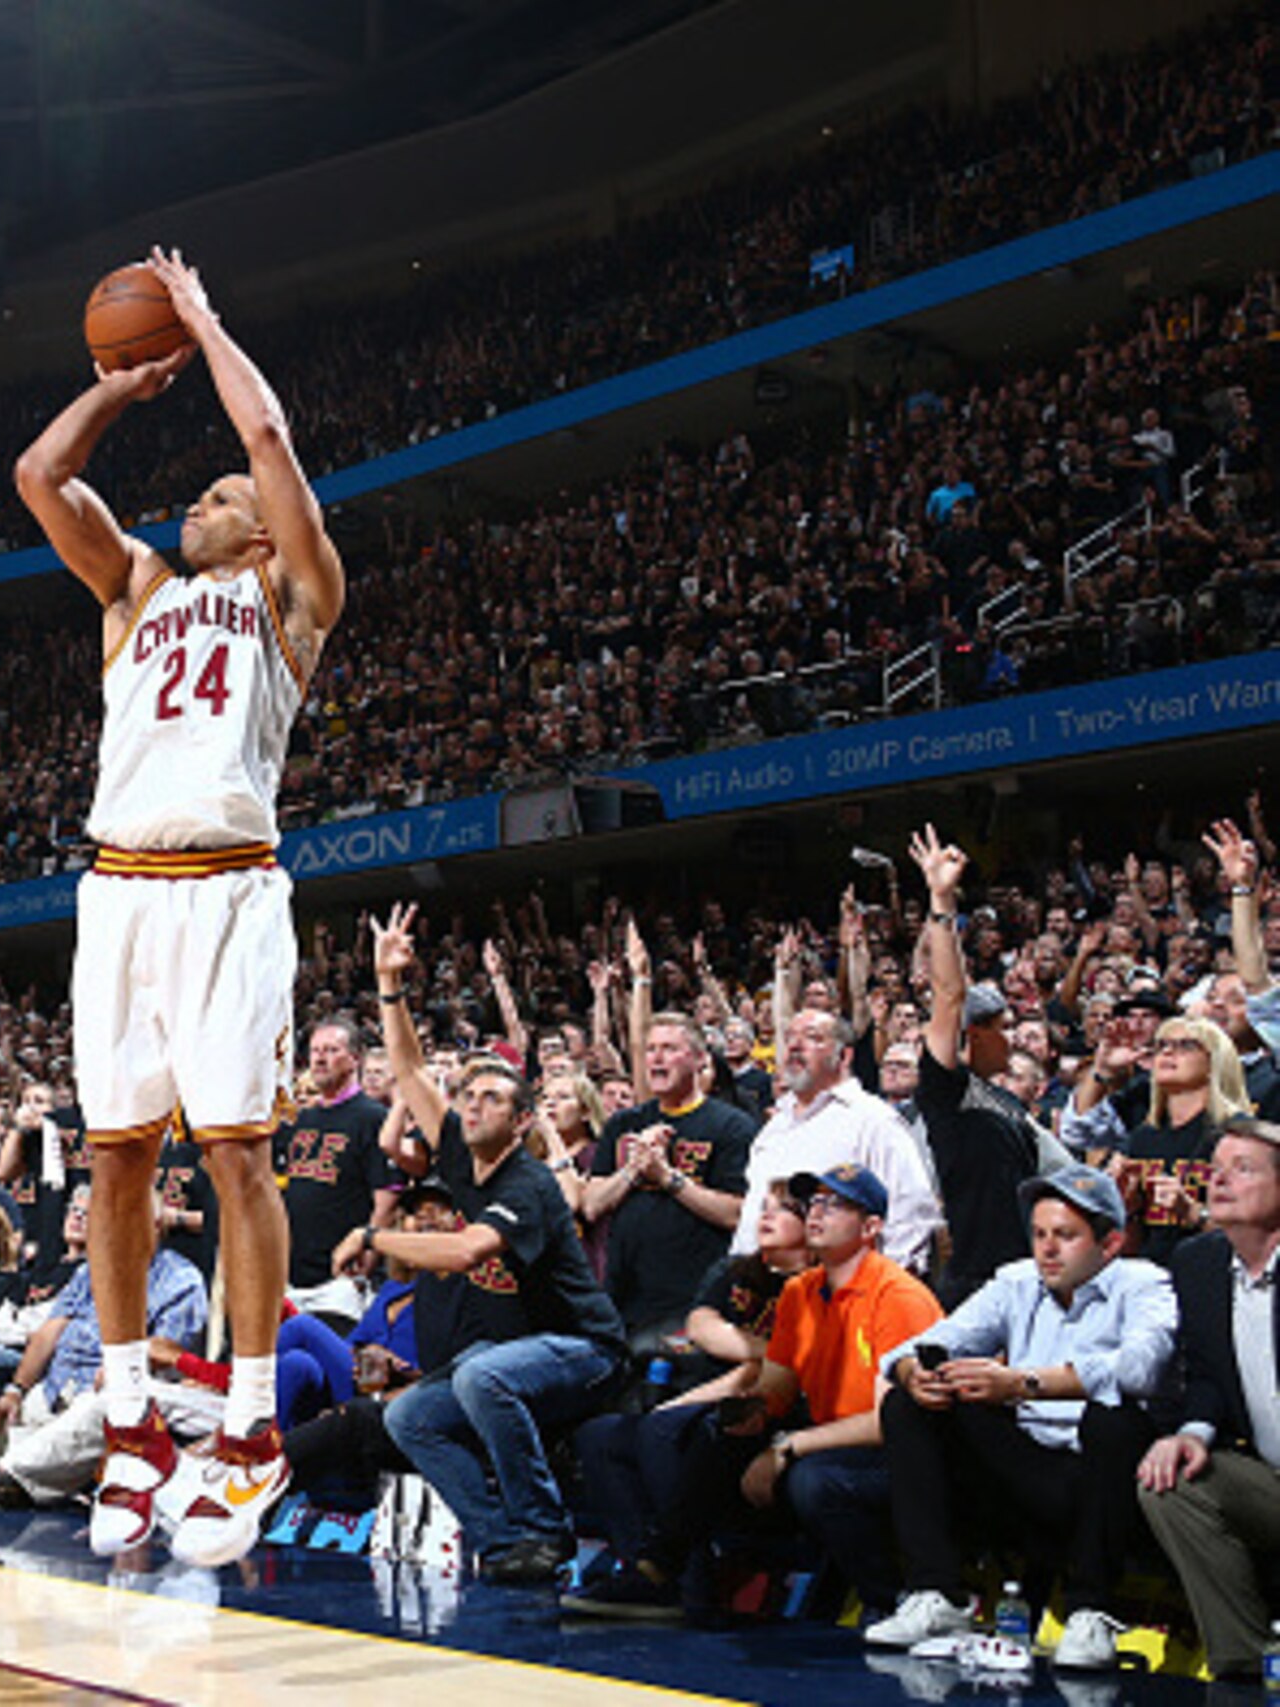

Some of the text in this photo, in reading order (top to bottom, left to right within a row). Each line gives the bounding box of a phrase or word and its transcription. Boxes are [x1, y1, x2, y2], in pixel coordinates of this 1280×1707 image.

[155, 642, 231, 721] 24
[675, 769, 722, 803] HiFi
[726, 761, 795, 794] Audio
[826, 741, 902, 778] 20MP
[908, 726, 1015, 764] Camera
[1055, 692, 1201, 738] Two-Year
[291, 821, 411, 873] AXON
